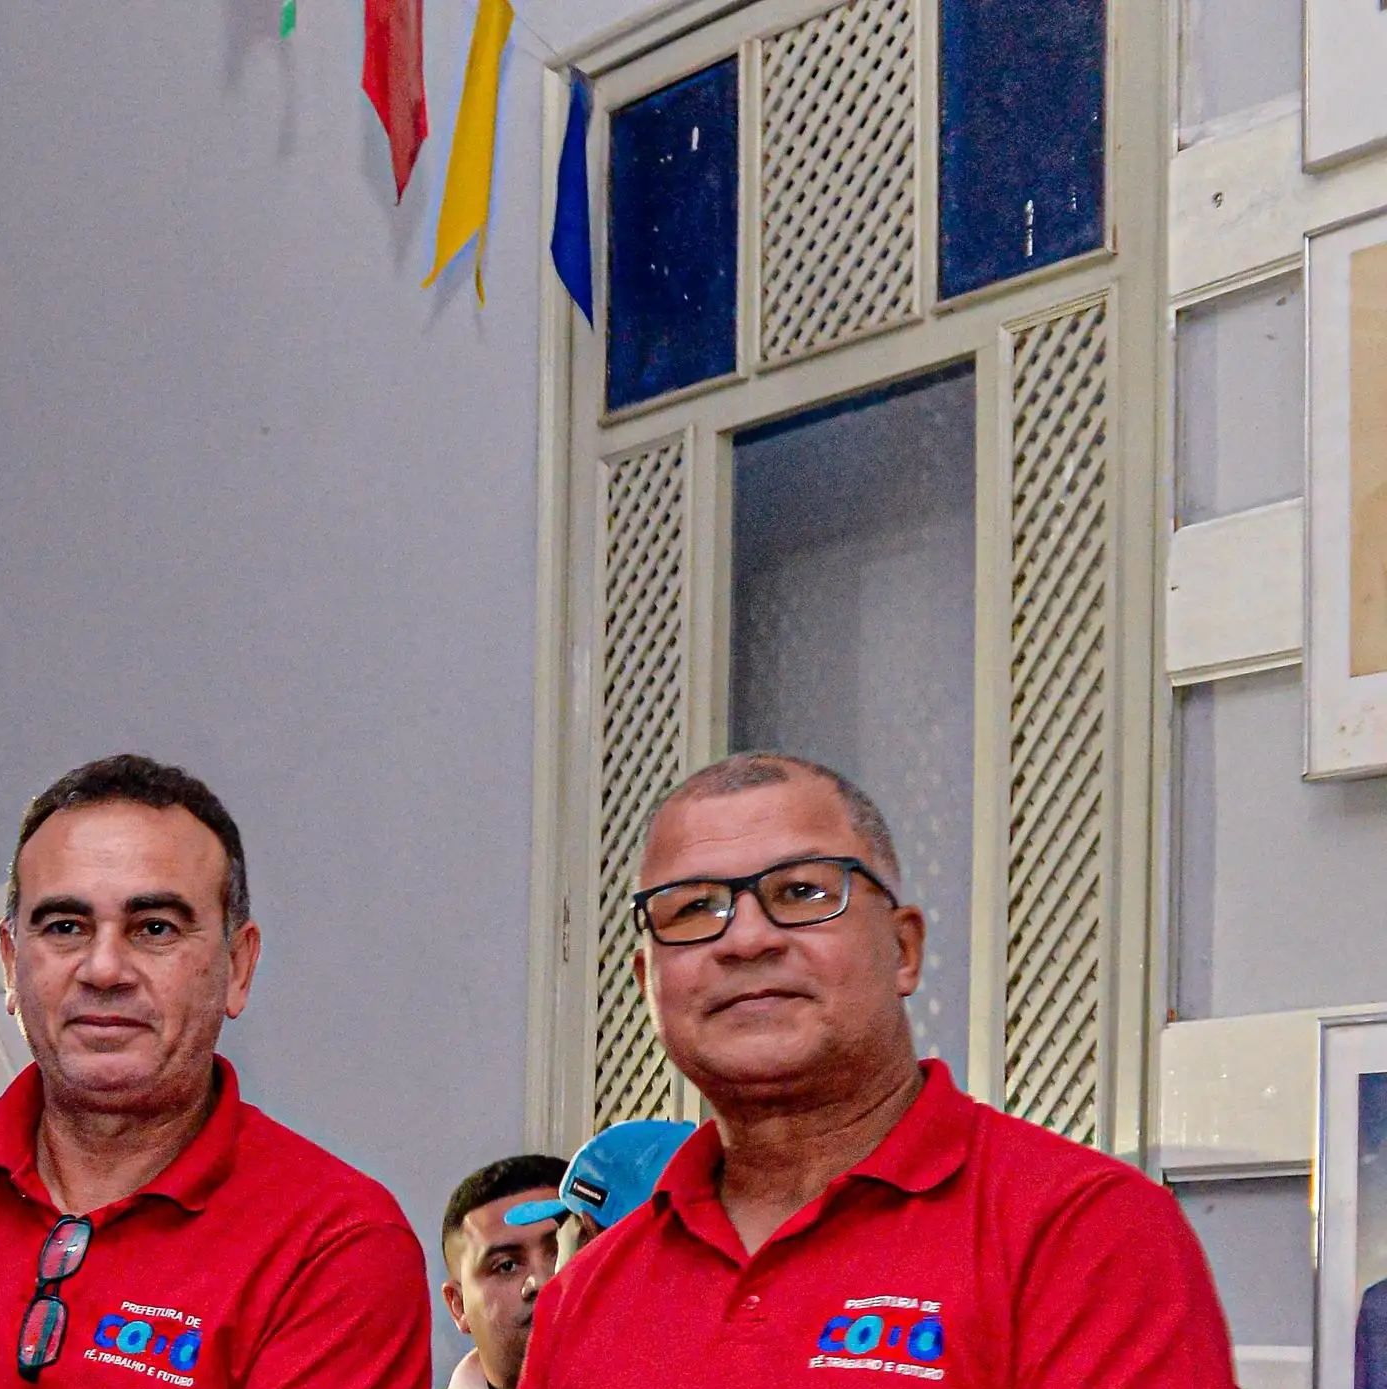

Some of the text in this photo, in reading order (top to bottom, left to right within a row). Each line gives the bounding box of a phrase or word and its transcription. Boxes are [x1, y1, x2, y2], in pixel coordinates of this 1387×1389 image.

[120, 1301, 203, 1329] PREFEITURA DE
[98, 1352, 146, 1373] TRABALHO
[146, 1365, 156, 1376] E
[156, 1369, 195, 1388] FUTURO
